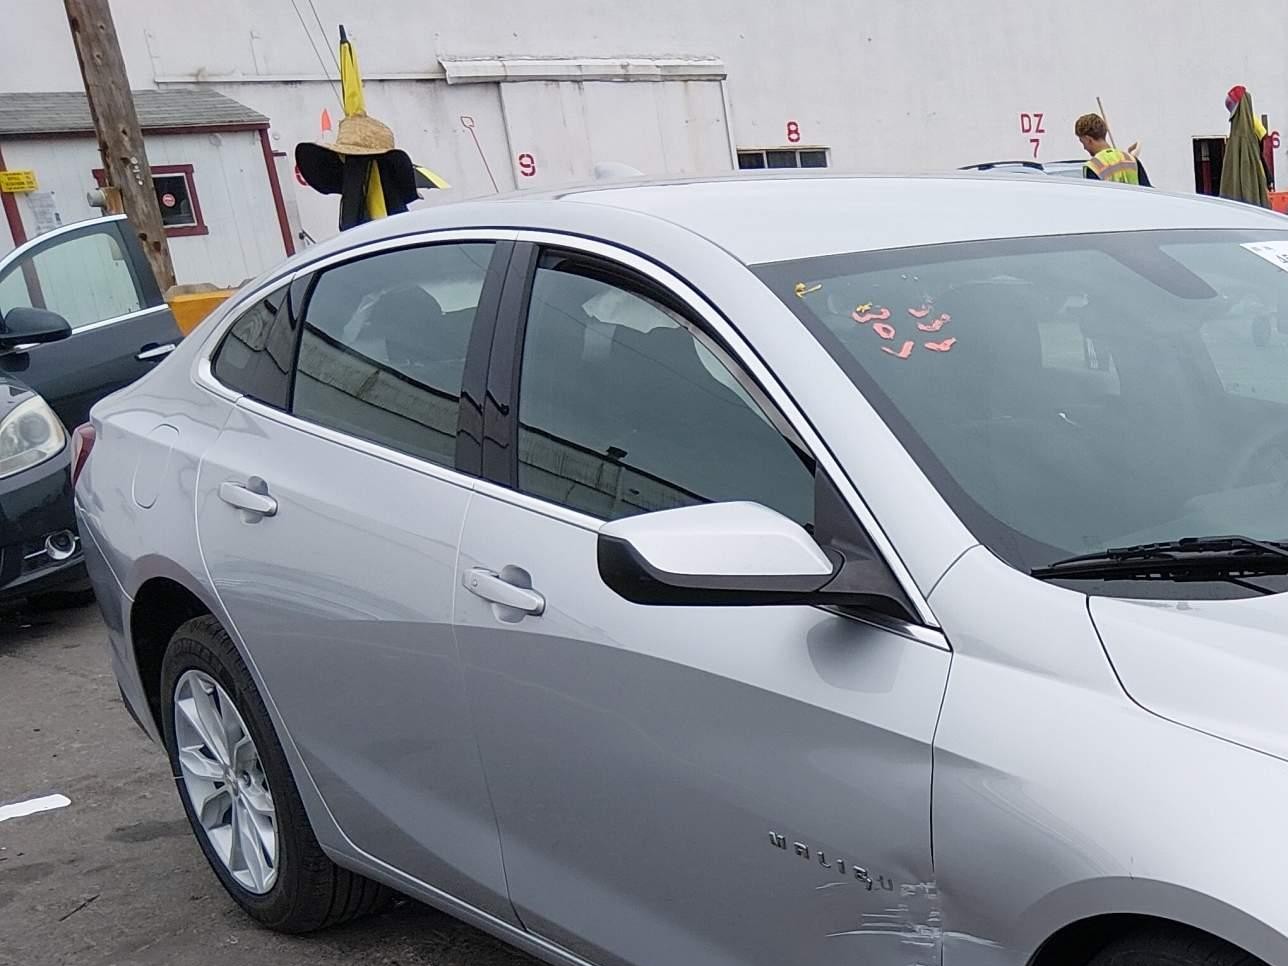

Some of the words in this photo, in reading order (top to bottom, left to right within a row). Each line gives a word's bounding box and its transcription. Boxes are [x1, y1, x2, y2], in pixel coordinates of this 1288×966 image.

[787, 121, 801, 143] 8
[1020, 113, 1046, 134] DZ
[1029, 138, 1041, 159] 7
[1271, 130, 1281, 149] 6
[518, 153, 536, 177] 9
